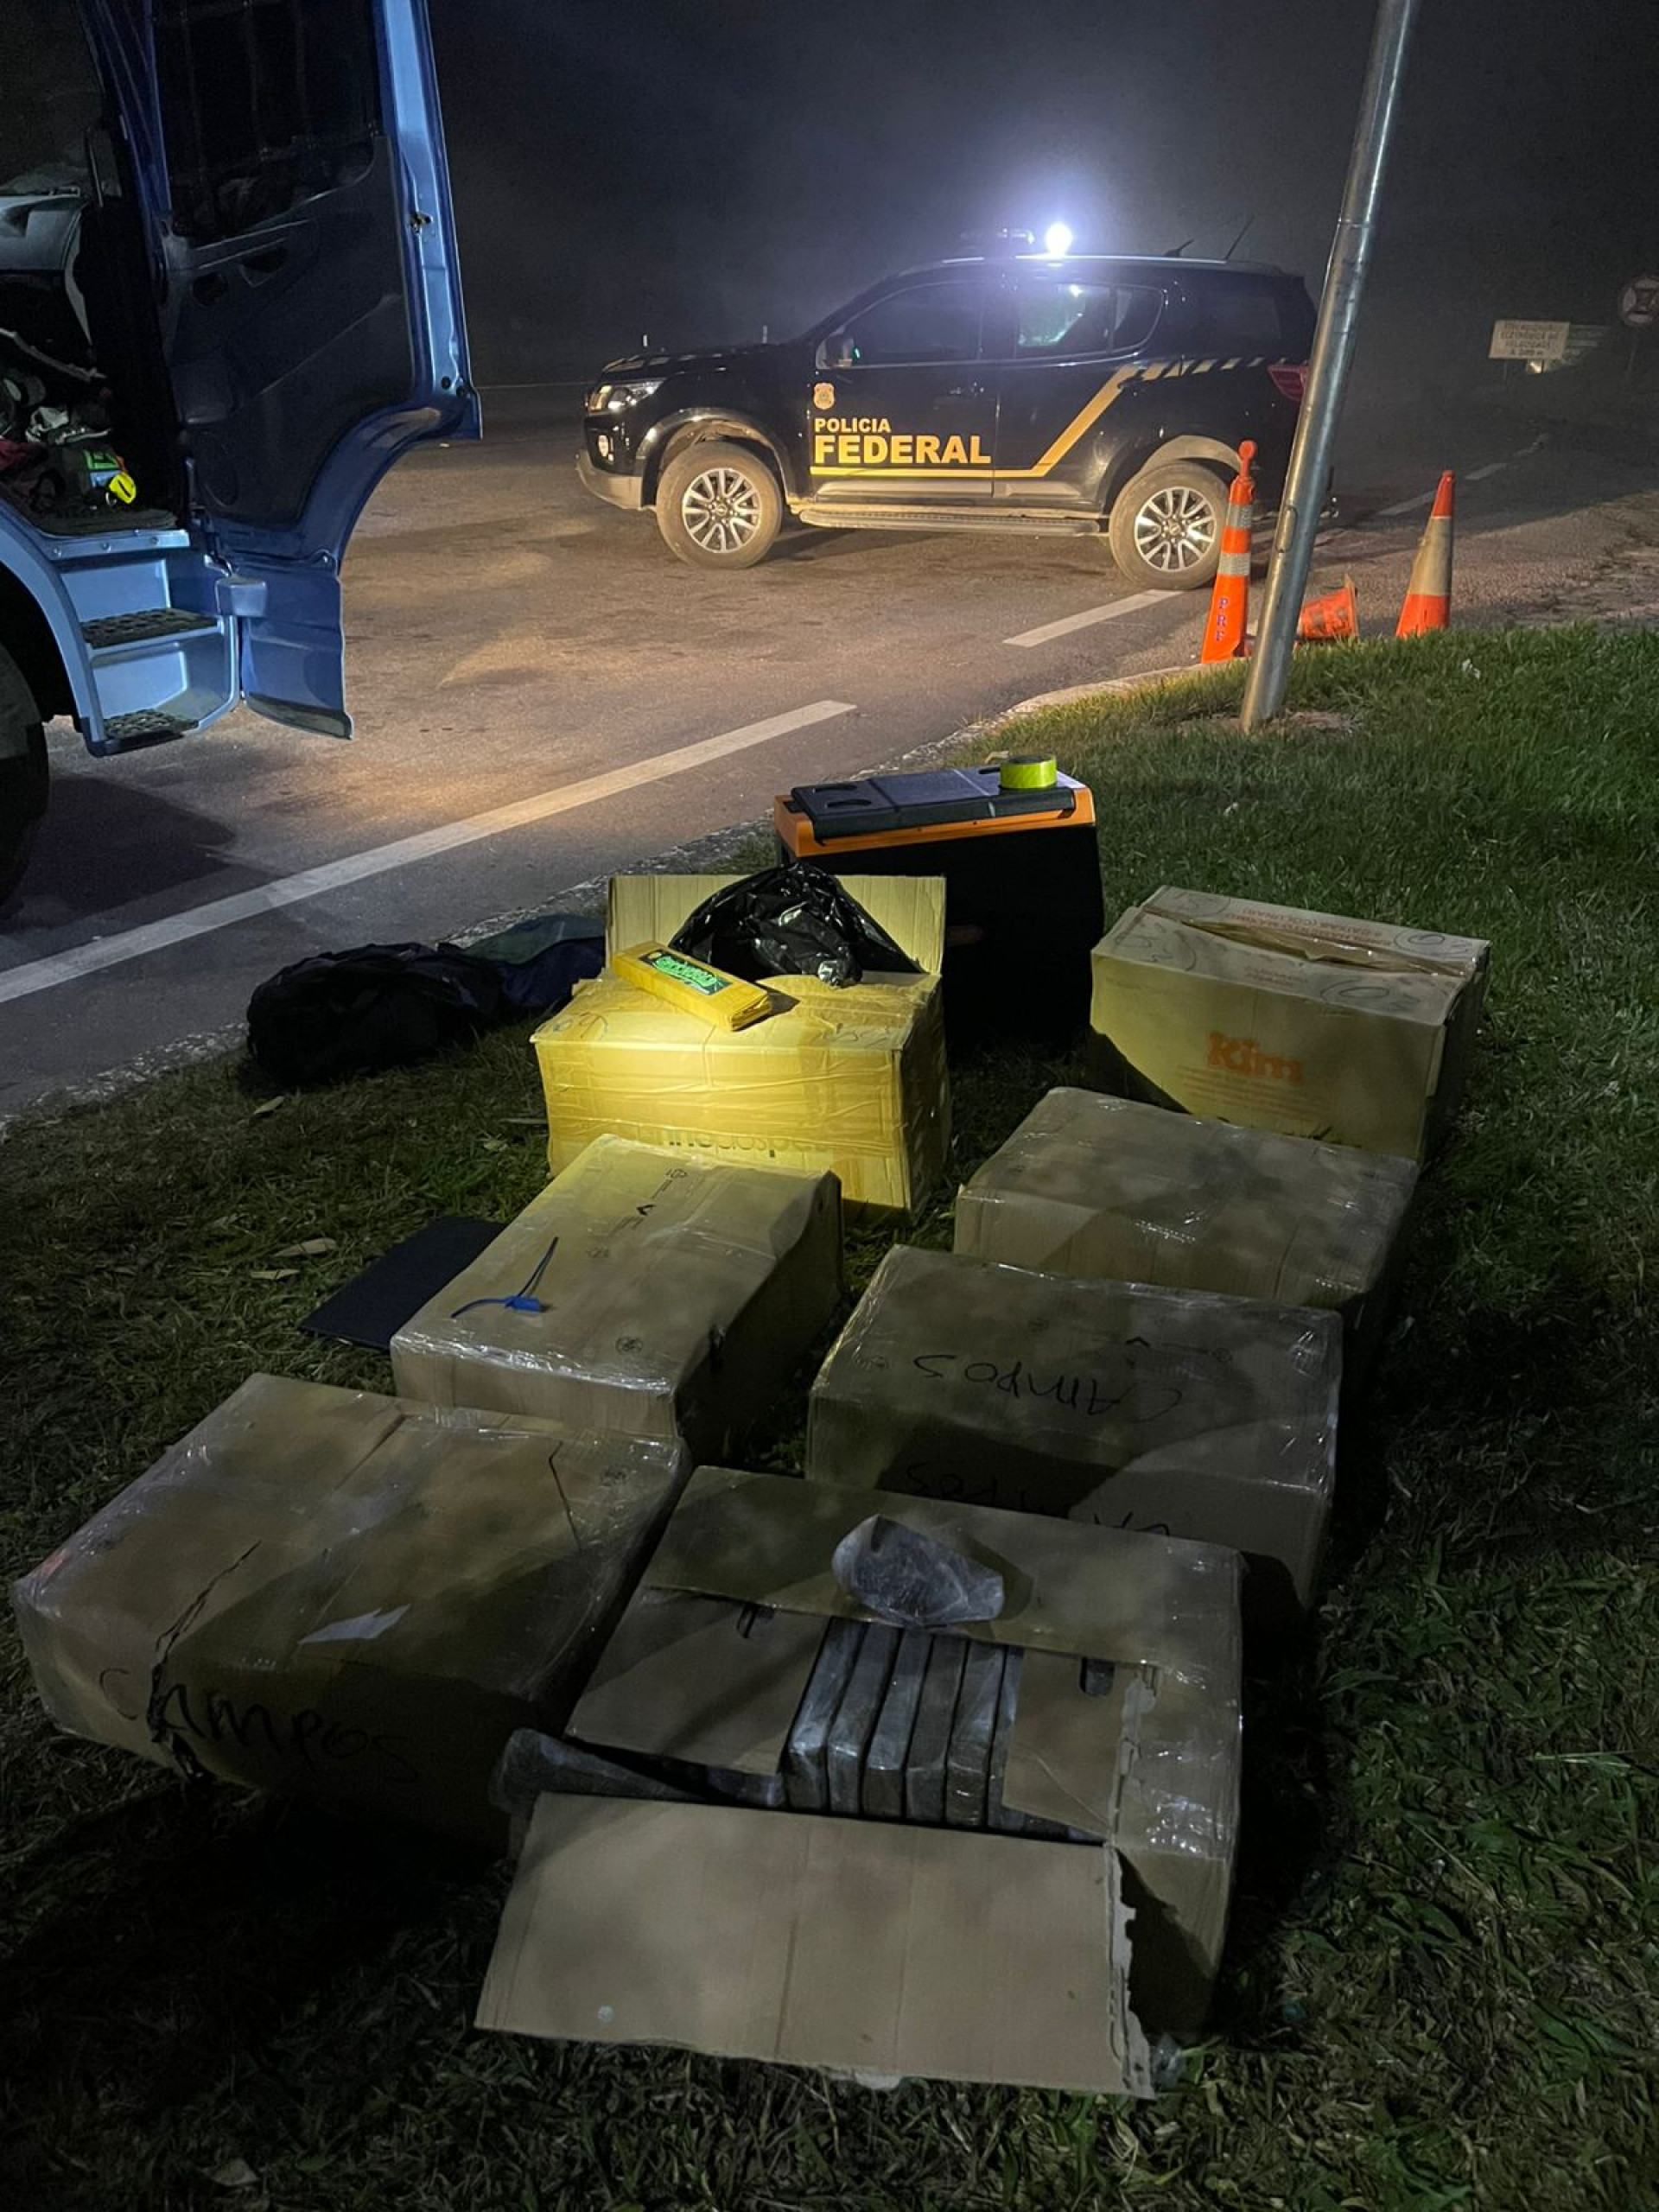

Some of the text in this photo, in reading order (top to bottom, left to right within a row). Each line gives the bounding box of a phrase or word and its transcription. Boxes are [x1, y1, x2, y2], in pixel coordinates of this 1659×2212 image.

[815, 435, 991, 464] FEDERAL
[1216, 596, 1228, 641] PRF
[1208, 1033, 1303, 1084] Kim
